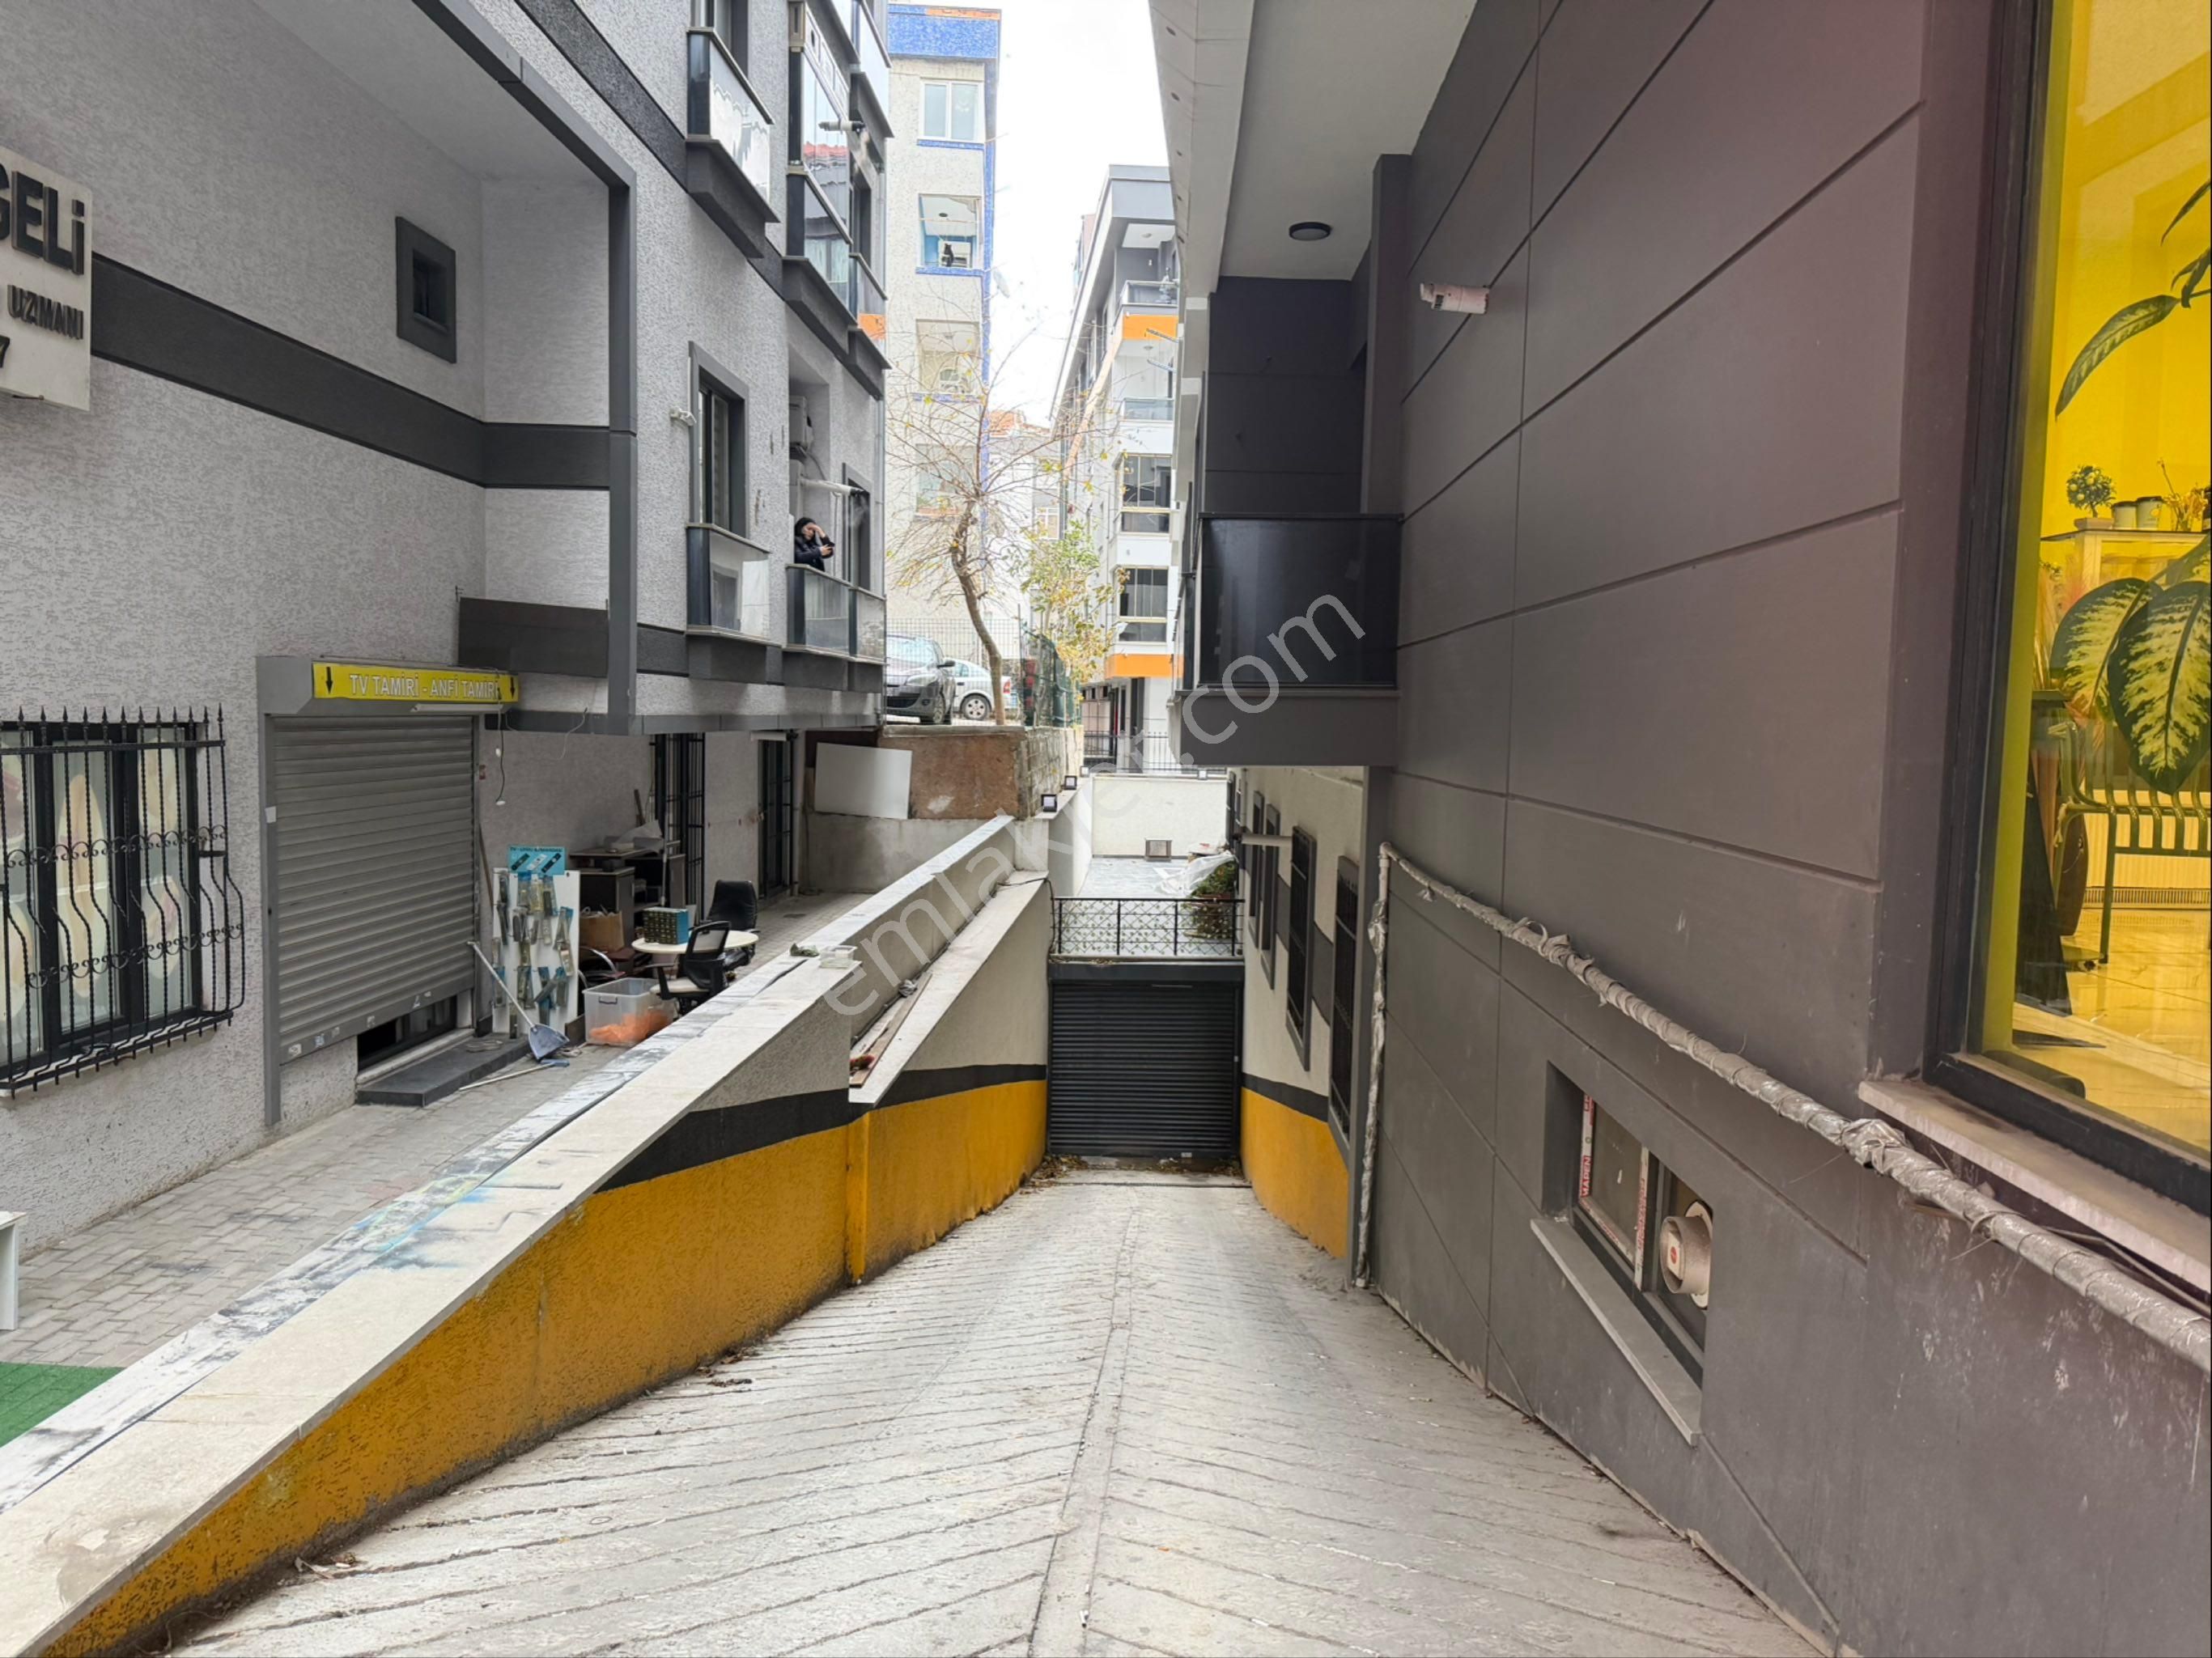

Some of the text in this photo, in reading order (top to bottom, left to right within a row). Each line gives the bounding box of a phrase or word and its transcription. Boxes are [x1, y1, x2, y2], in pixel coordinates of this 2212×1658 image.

[7, 284, 84, 340] UZMANI
[350, 674, 369, 695] TV
[372, 672, 419, 697] TAMİRİ
[431, 675, 459, 697] ANFİ
